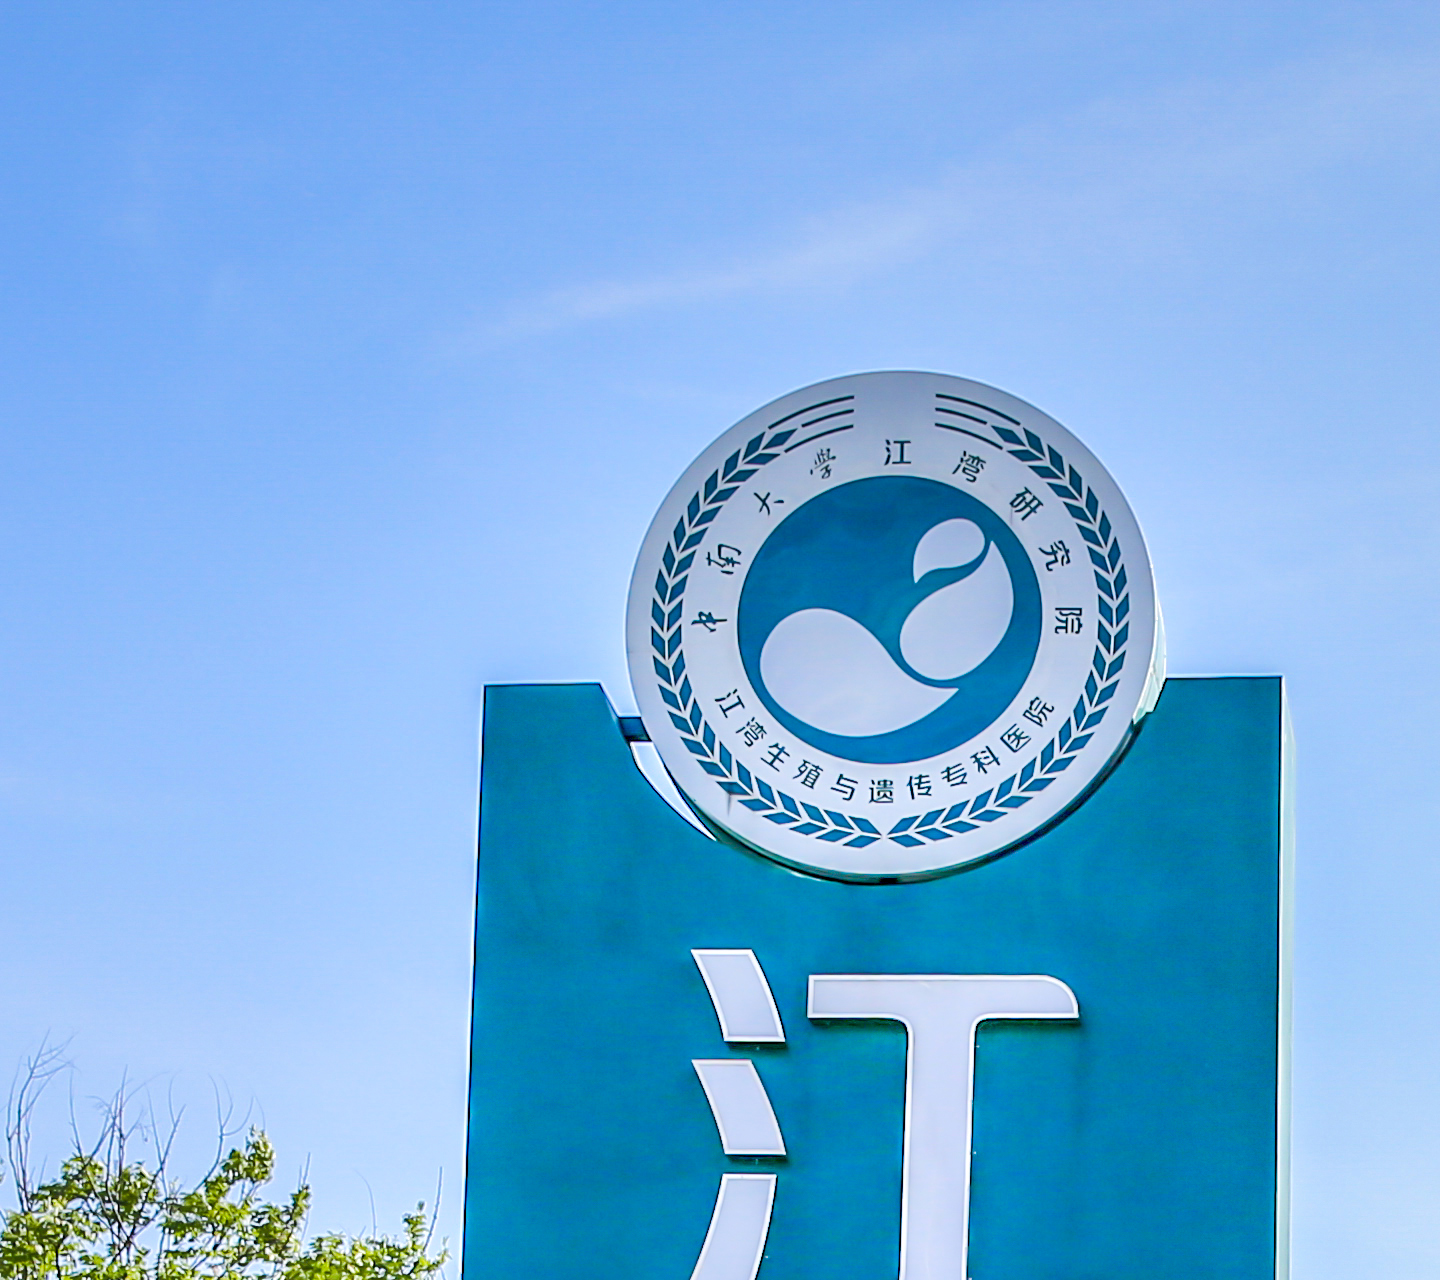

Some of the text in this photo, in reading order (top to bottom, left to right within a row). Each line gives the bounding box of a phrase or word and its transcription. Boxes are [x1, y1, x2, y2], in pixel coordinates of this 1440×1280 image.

[713, 688, 1056, 804] 江湾生殖与遗传专科医院
